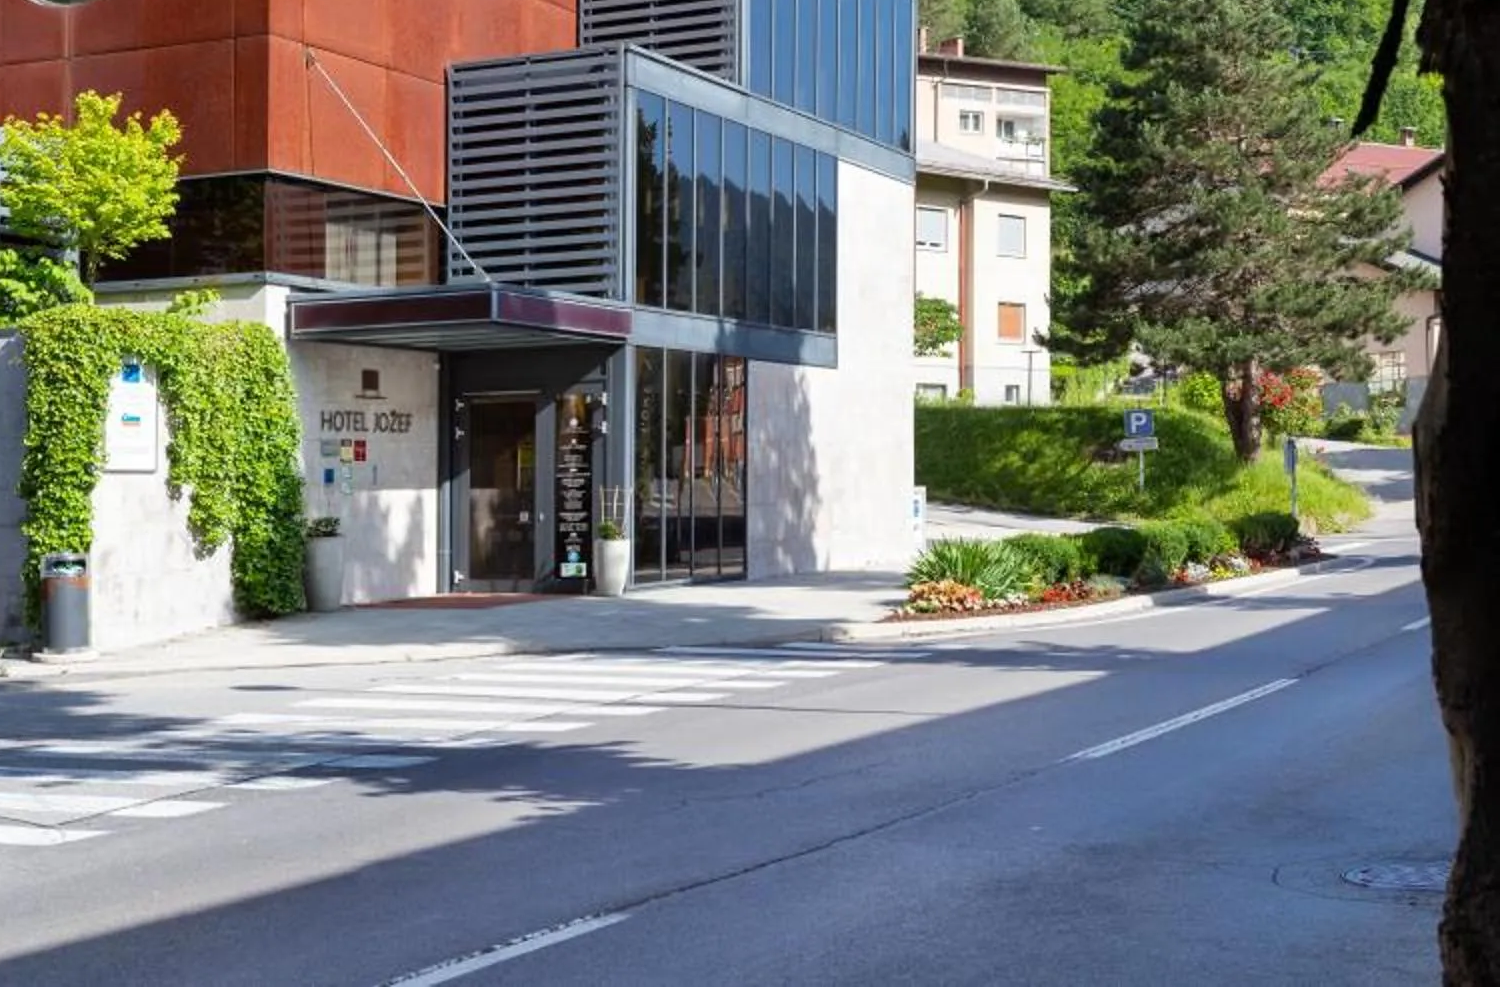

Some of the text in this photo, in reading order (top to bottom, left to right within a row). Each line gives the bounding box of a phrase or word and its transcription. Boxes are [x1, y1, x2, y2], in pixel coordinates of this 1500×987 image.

[320, 409, 412, 433] HOTEL JOŽEF
[1131, 412, 1147, 433] P
